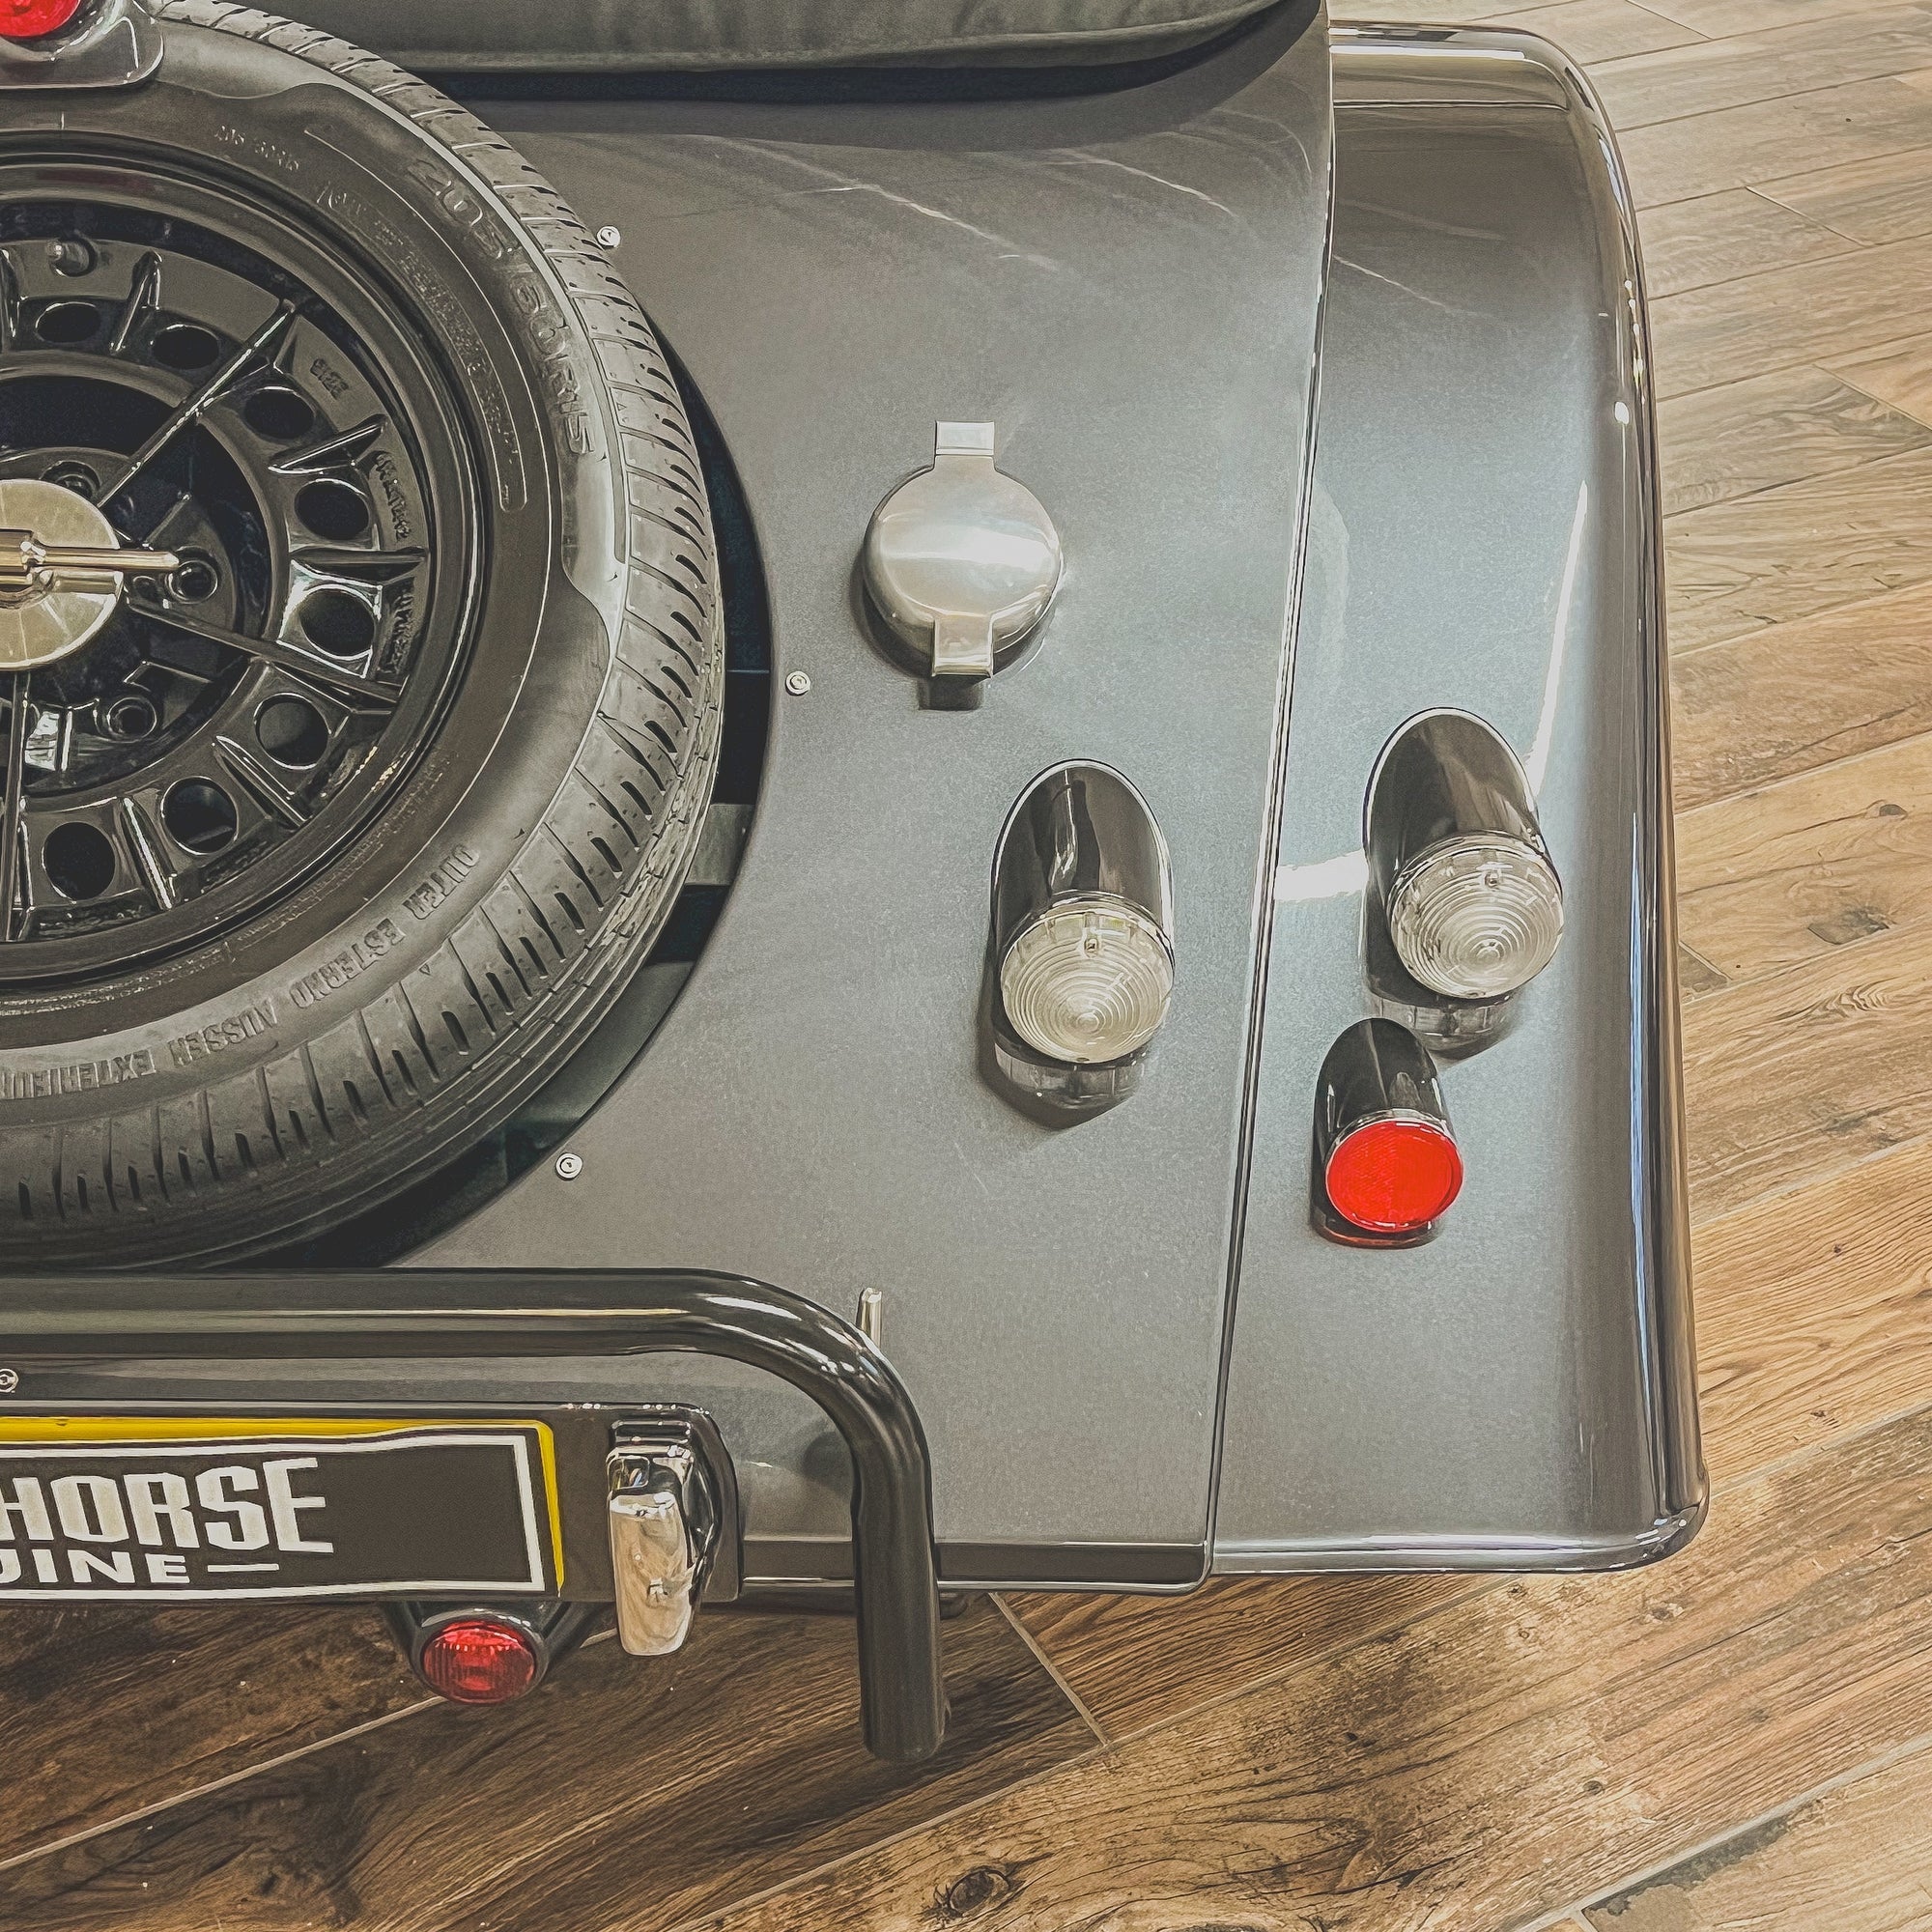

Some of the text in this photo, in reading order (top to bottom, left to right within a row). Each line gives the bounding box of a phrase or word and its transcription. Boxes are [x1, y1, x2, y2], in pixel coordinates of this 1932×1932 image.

[402, 843, 480, 920] OUTER
[289, 918, 407, 1009] ESTERNO
[167, 998, 278, 1067] AUSSEN
[0, 1457, 334, 1553] HORSE
